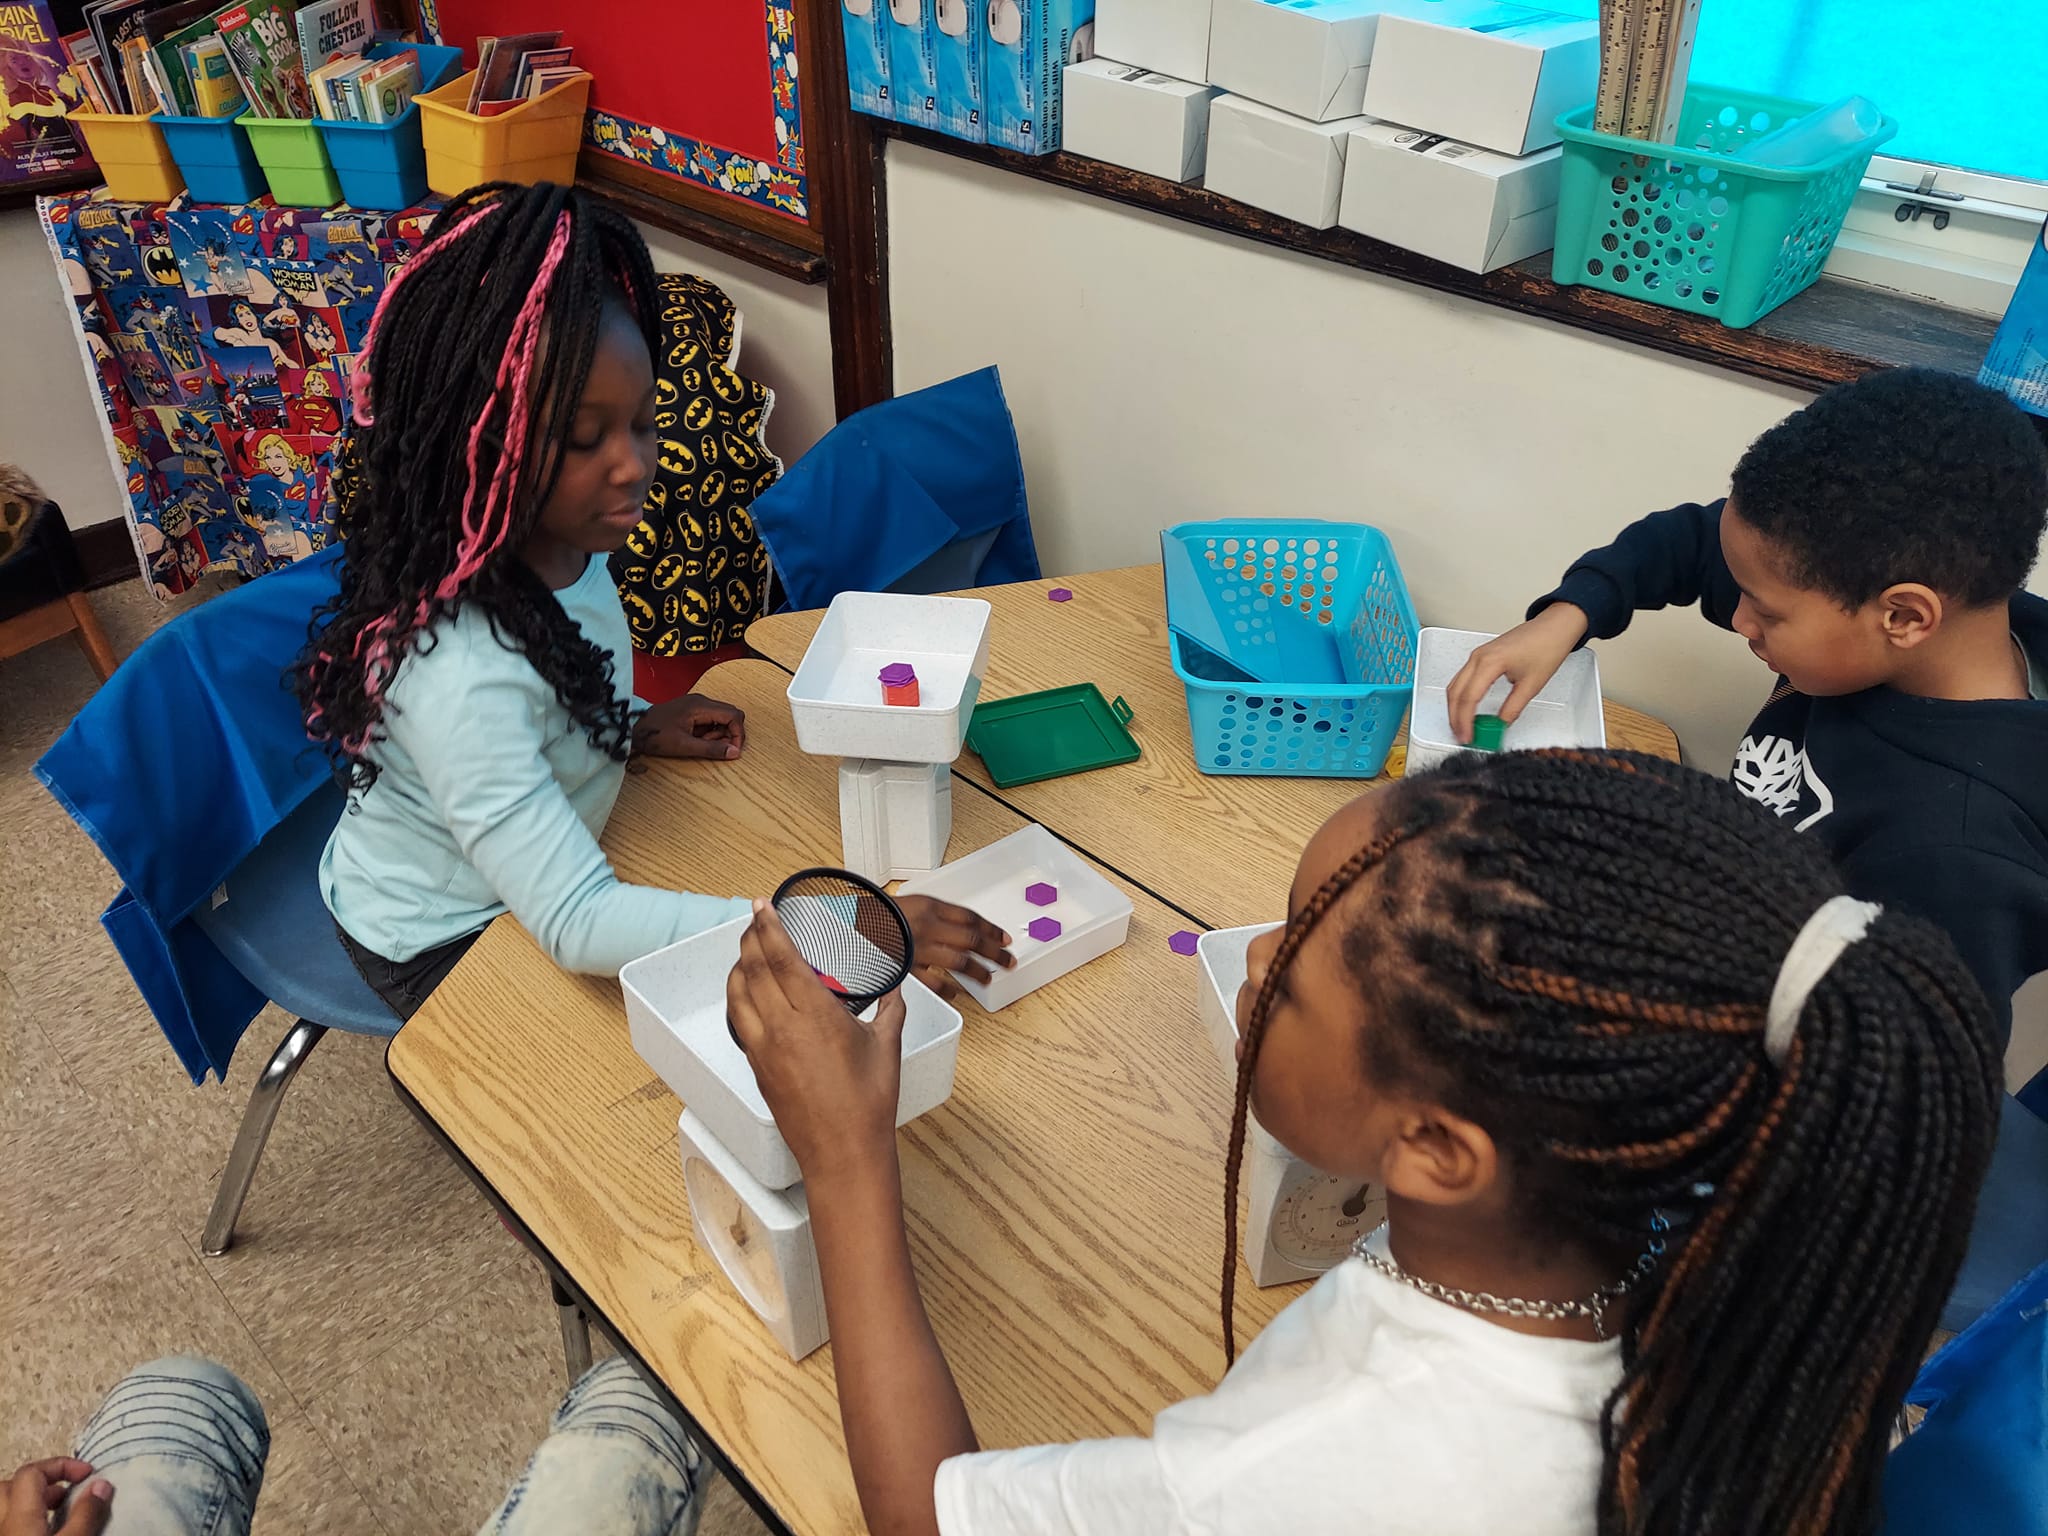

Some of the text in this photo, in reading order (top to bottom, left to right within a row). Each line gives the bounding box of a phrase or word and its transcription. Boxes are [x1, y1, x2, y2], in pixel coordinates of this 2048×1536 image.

[251, 12, 287, 47] BIG
[319, 1, 359, 34] FOLLOW
[318, 19, 367, 55] CHESTER!
[1060, 28, 1068, 66] Digital
[266, 38, 297, 66] BOOK
[1051, 99, 1059, 121] Cup
[1041, 100, 1050, 151] compacte
[1051, 123, 1059, 149] Bowl
[727, 164, 754, 187] POW!
[79, 209, 118, 229] BATGIRL
[327, 223, 363, 244] BATGIRL
[271, 268, 313, 281] WONDER
[273, 278, 316, 290] WOMAN
[160, 503, 181, 526] ONDER
